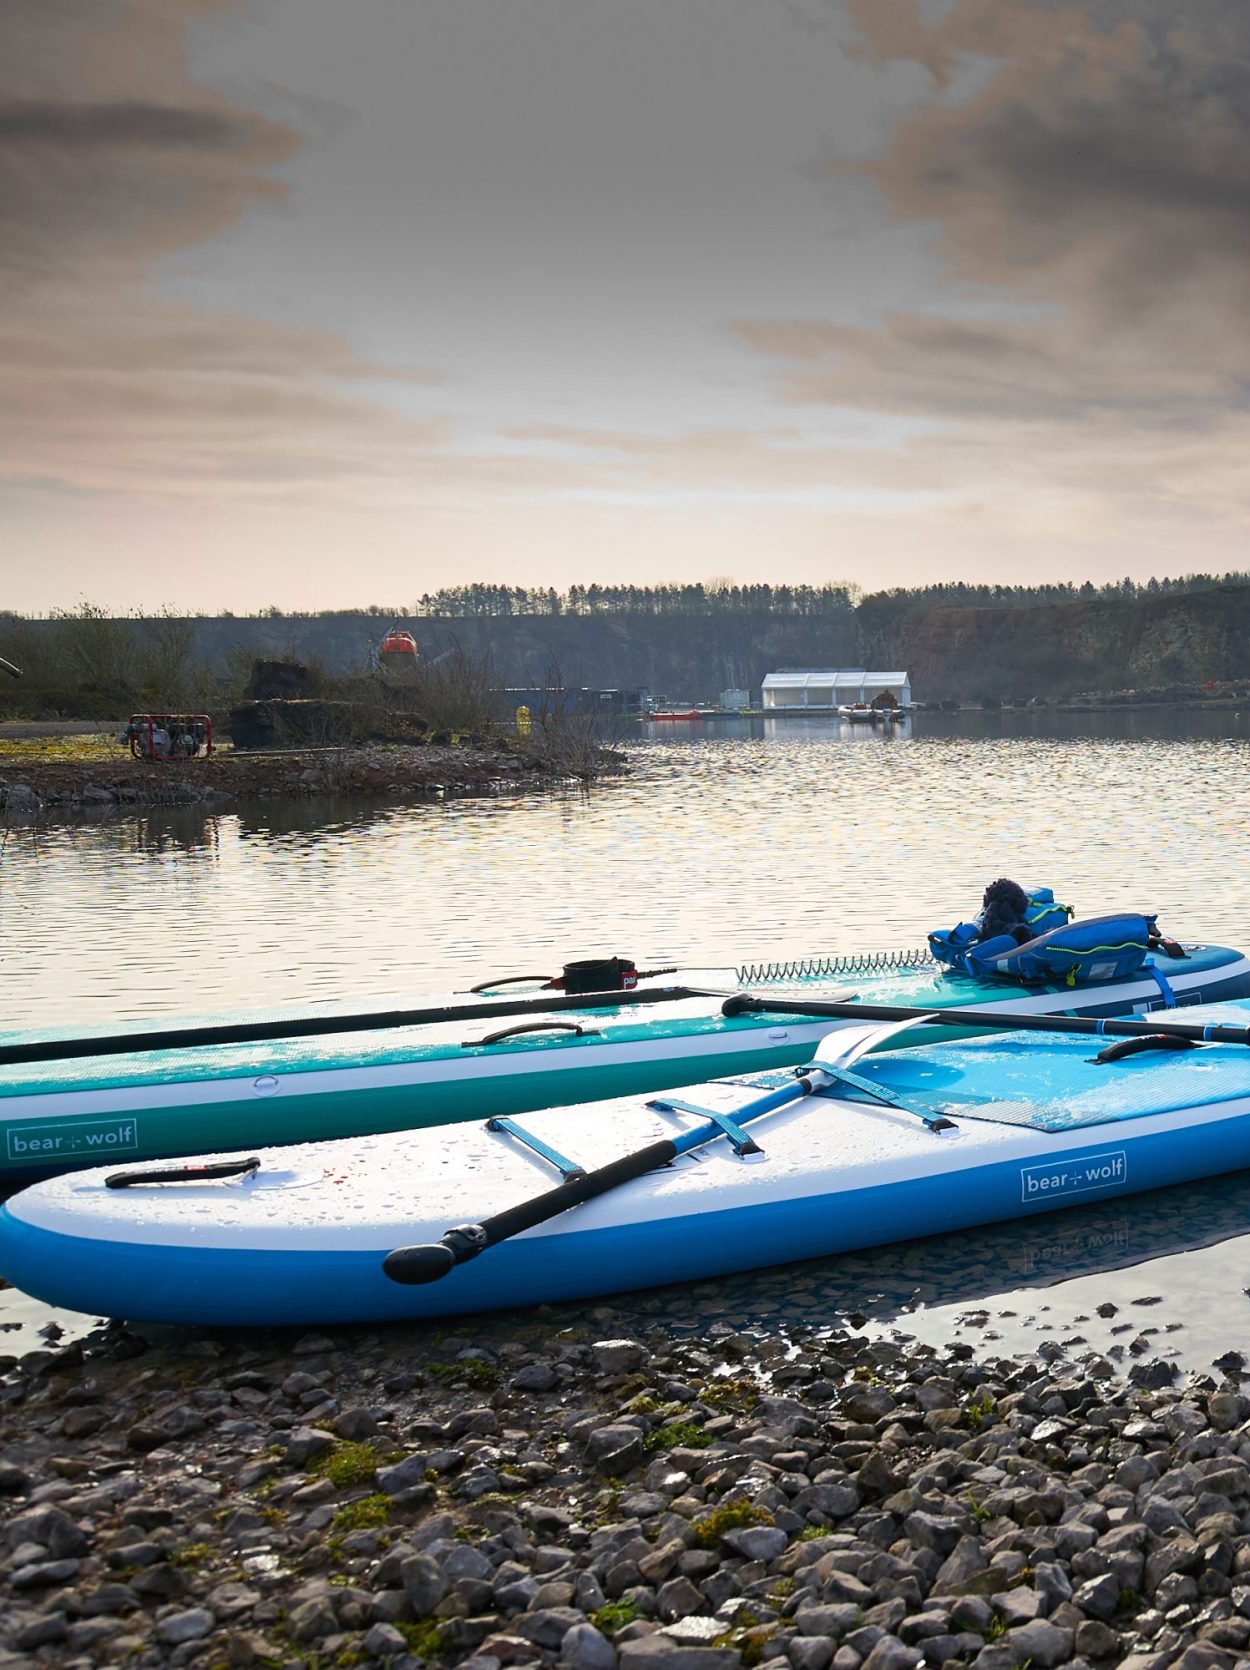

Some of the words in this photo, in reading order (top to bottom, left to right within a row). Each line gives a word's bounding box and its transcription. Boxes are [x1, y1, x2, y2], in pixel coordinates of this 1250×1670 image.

[13, 1136, 63, 1152] bear
[85, 1126, 133, 1146] wolf
[1027, 1175, 1068, 1192] bear
[1085, 1158, 1123, 1182] wolf
